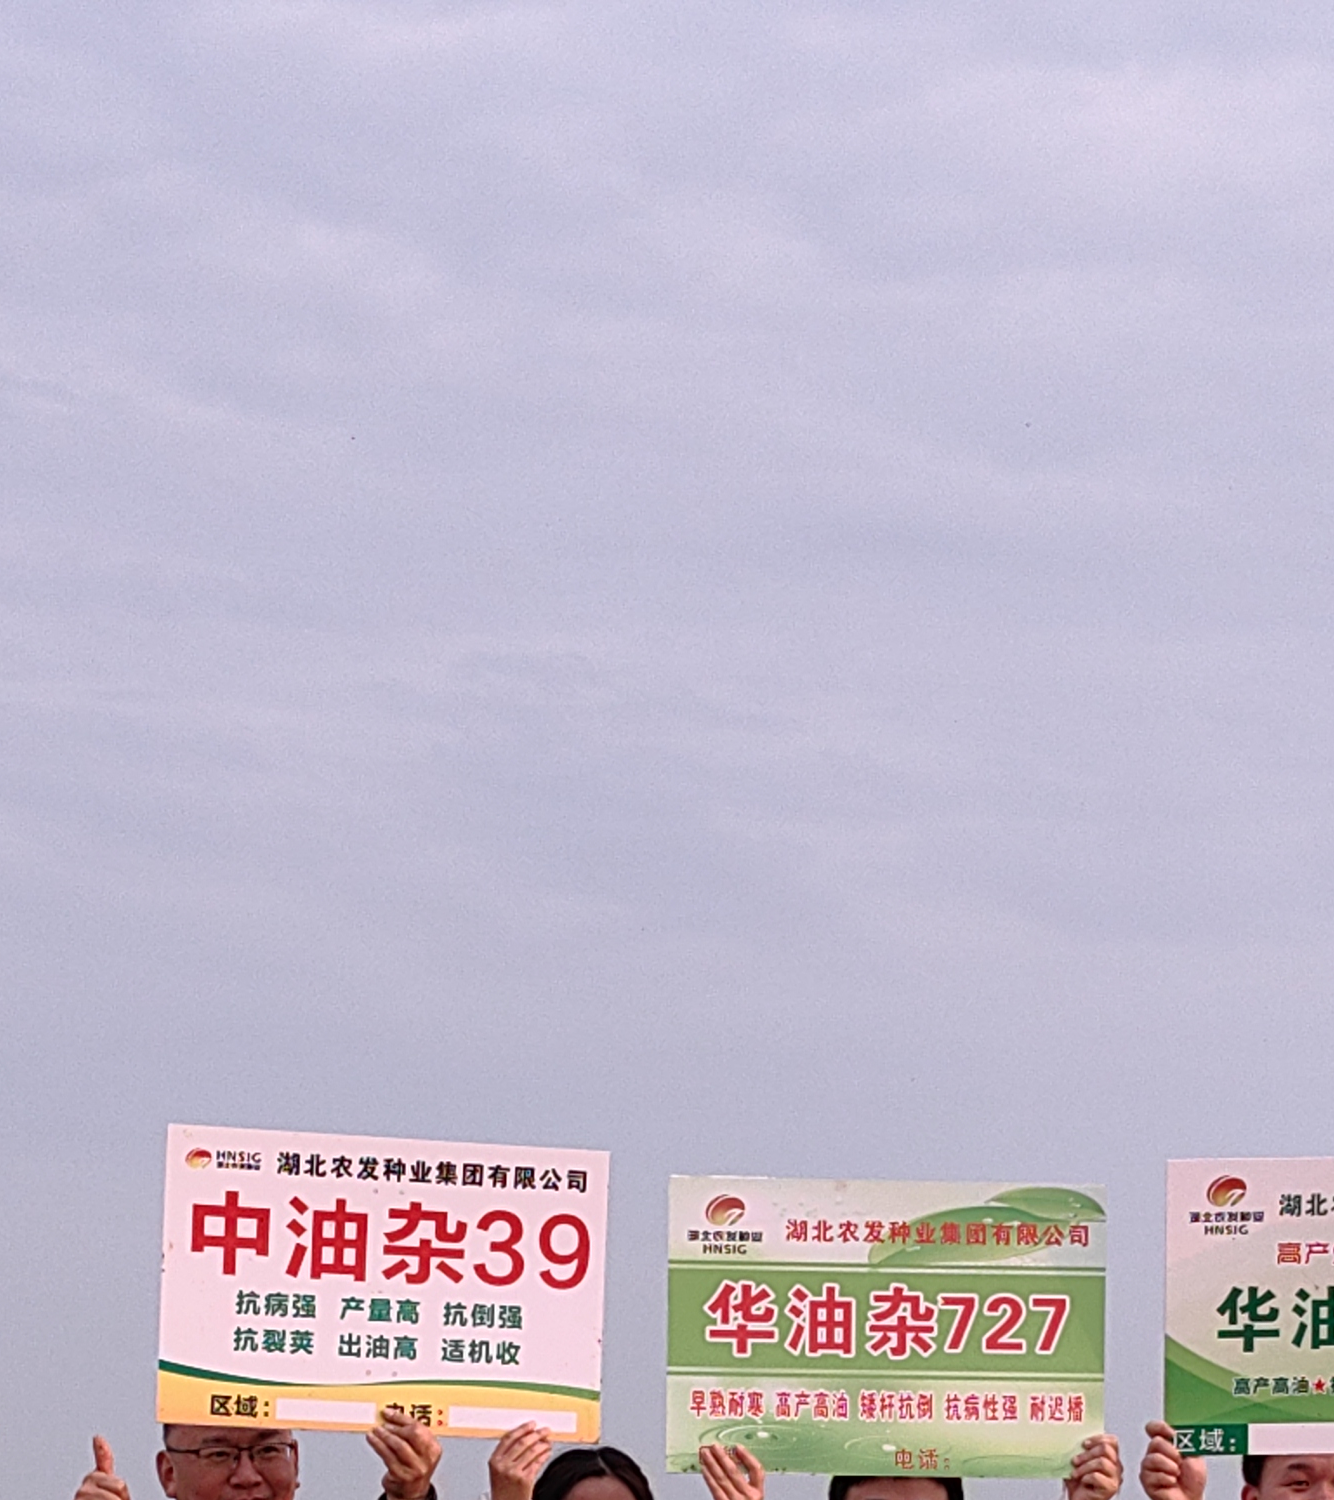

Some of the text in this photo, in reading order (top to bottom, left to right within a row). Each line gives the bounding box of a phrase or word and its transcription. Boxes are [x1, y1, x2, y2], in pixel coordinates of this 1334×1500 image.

[276, 1151, 589, 1194] 湖北农发种业集团有限公司
[190, 1190, 592, 1290] 中油杂39
[785, 1217, 1090, 1248] 湖北农发种业集团有限公司
[1203, 1225, 1249, 1236] HNSIG
[702, 1244, 748, 1255] HNSIG
[235, 1290, 523, 1330] 抗病强 产量高 抗倒强
[706, 1282, 1069, 1358] 华油杂727
[232, 1327, 521, 1366] 抗裂荚 出油高 适机收
[1232, 1376, 1308, 1395] 高产高油
[209, 1394, 270, 1419] 区域：
[689, 1390, 764, 1419] 早熟耐寒
[775, 1391, 849, 1420] 高产高油
[943, 1393, 1018, 1422] 抗病性强
[1029, 1395, 1085, 1424] 耐迟播
